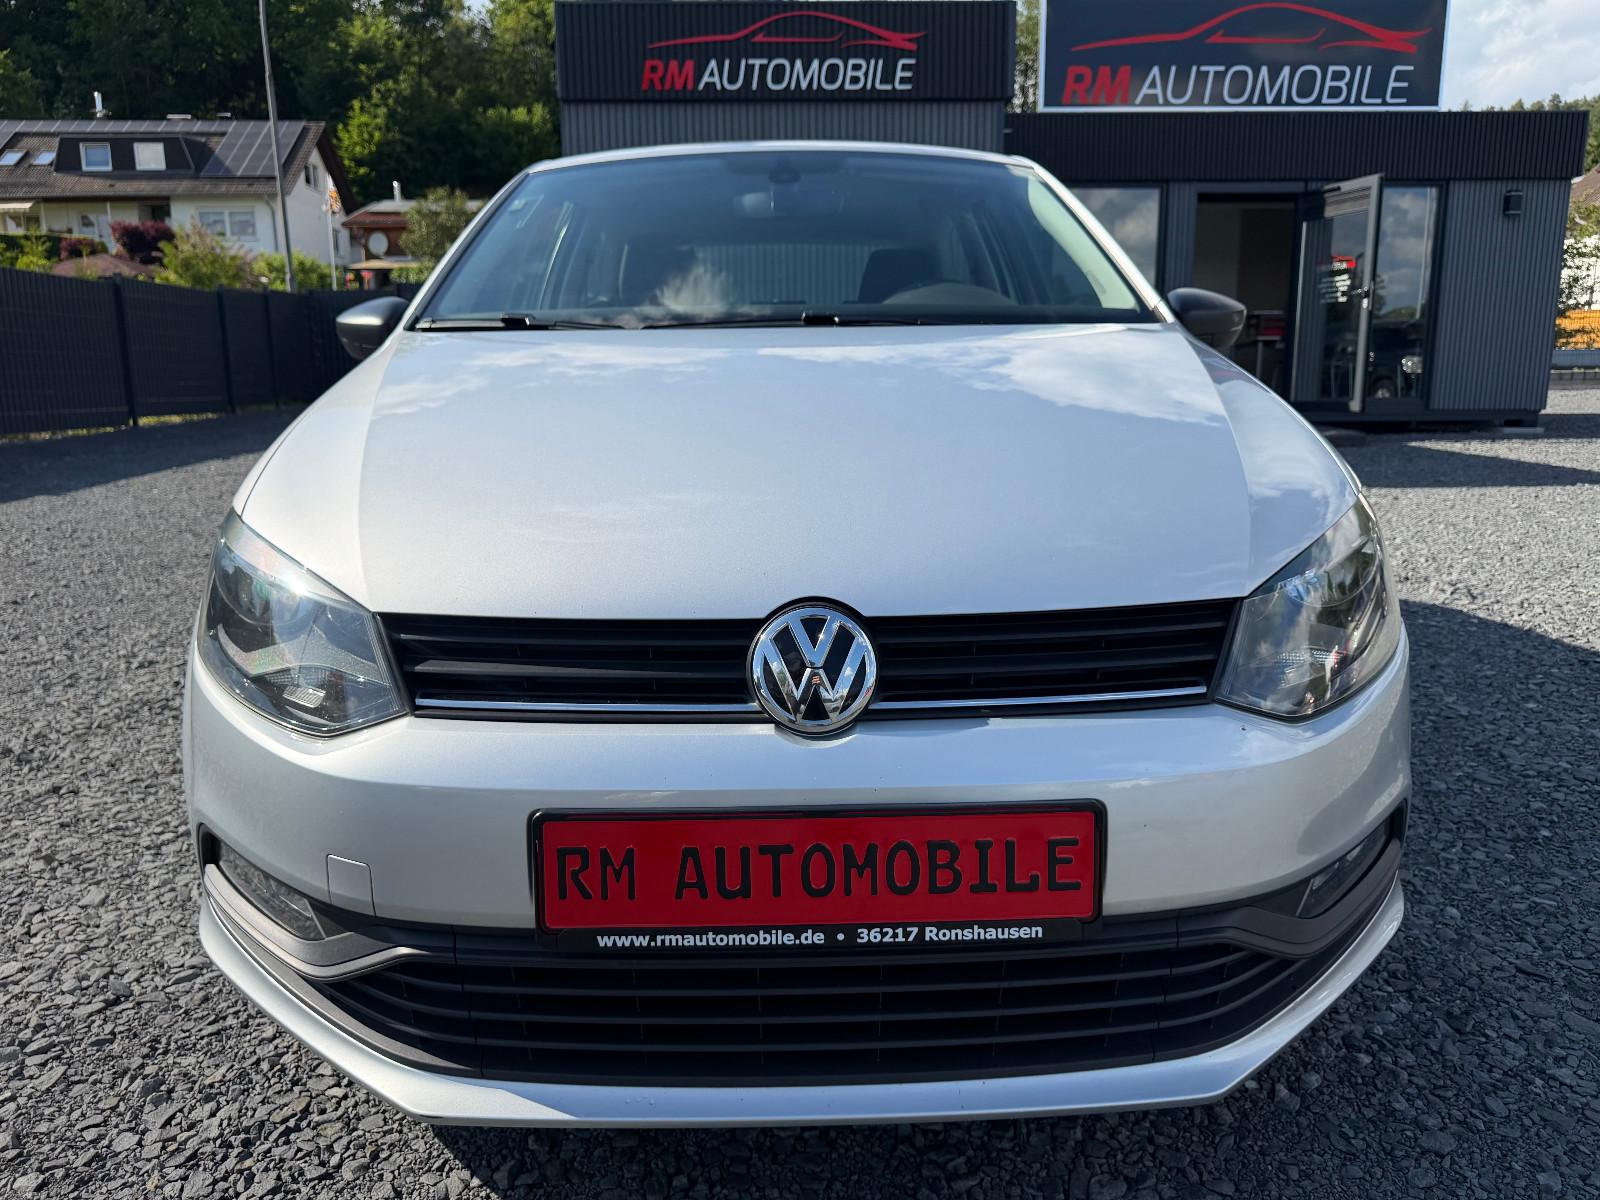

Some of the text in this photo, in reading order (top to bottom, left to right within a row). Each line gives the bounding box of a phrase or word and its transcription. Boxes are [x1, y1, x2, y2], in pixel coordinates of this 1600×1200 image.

[641, 57, 917, 92] RM AUTOMOBILE
[1062, 64, 1414, 105] RM AUTOMOBILE
[556, 838, 1082, 900] RM AUTOMOBILE
[596, 925, 1043, 948] www.rmautomobile.de 36217 Ronshausen
